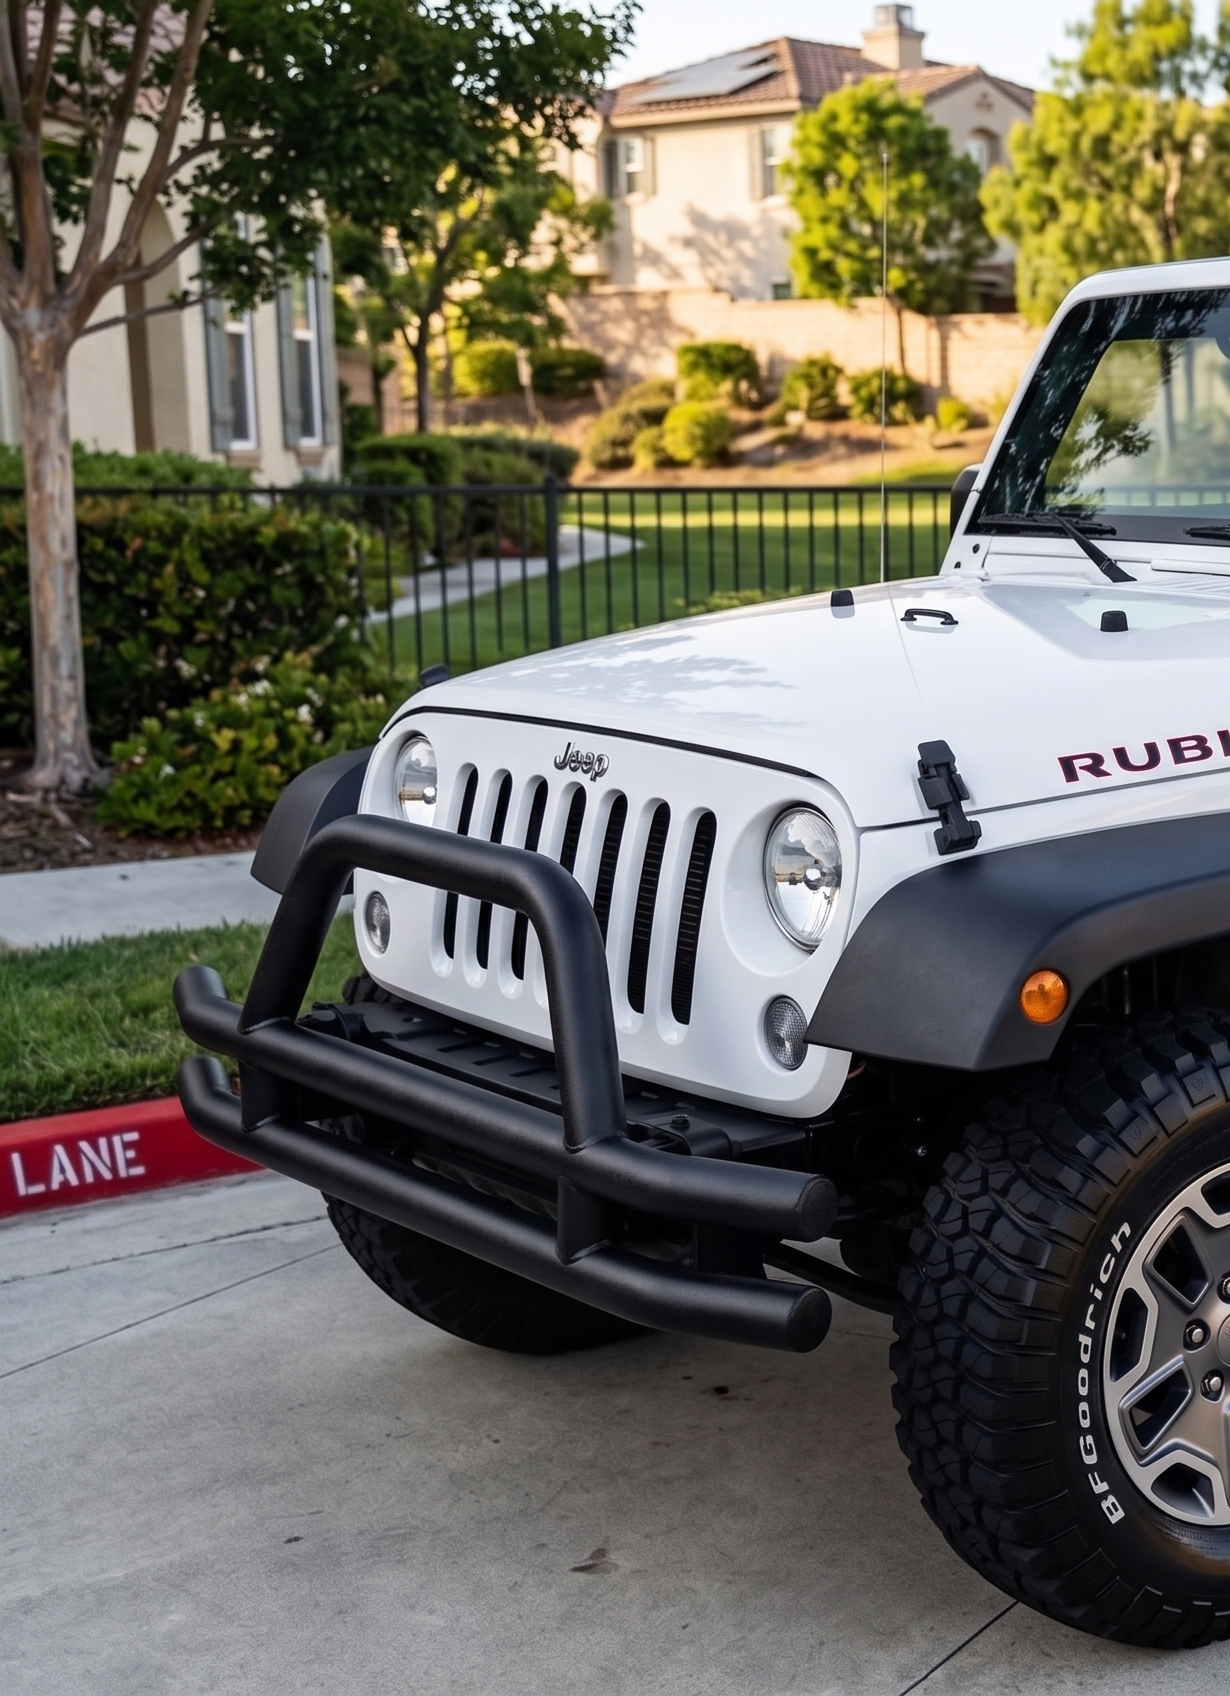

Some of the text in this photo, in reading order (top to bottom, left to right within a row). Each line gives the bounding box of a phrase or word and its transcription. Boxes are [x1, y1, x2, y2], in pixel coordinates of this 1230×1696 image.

[553, 741, 610, 782] Jeep
[10, 1130, 147, 1197] LANE
[1077, 1221, 1132, 1525] BFGoodrich
